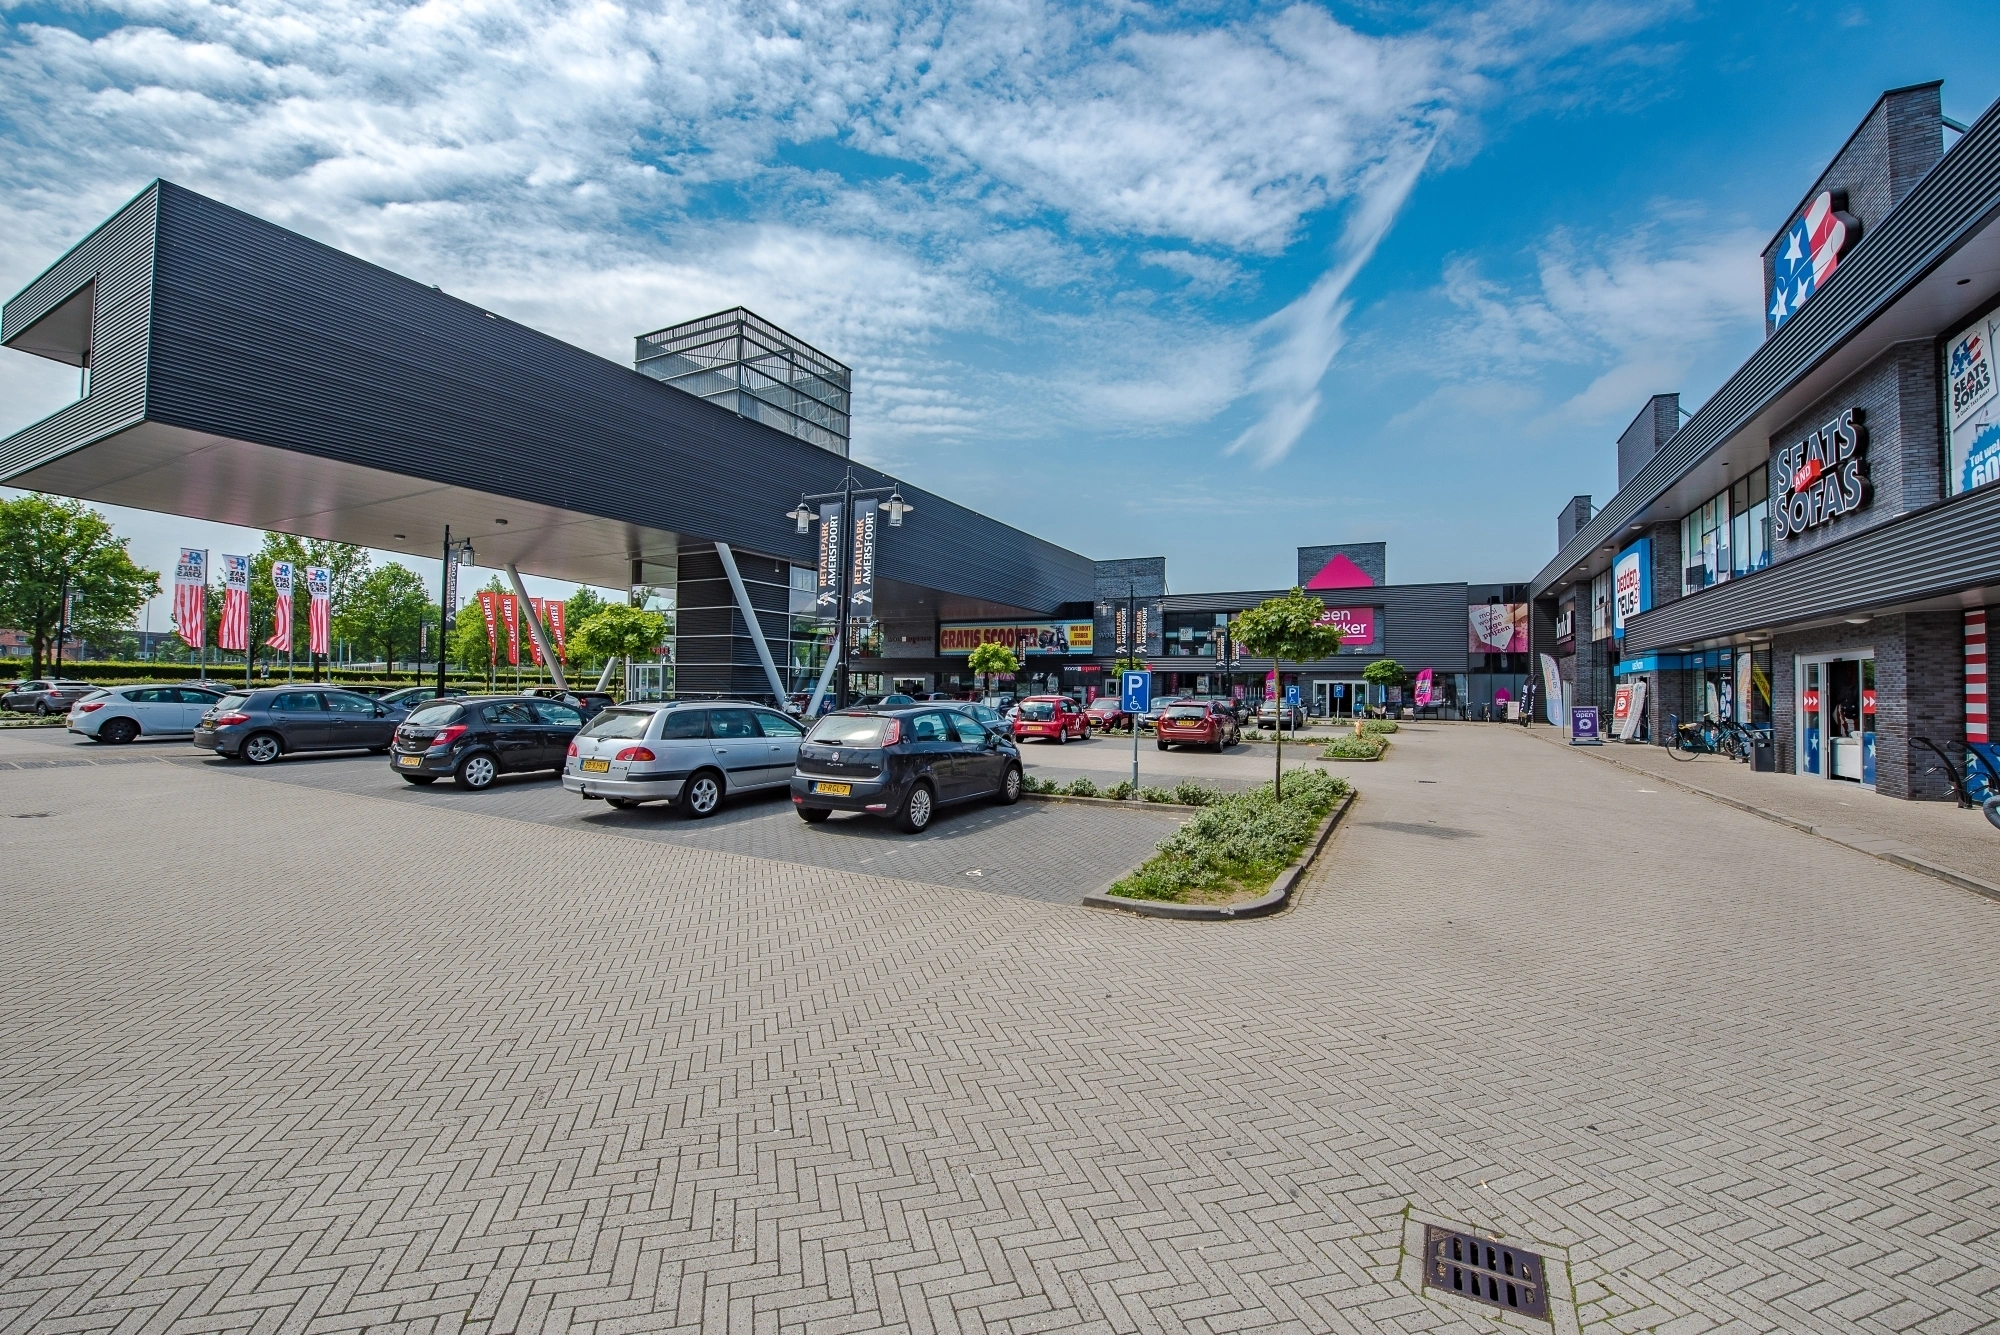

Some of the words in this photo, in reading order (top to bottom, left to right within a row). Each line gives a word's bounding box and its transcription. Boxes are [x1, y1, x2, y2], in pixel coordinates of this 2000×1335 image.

[1954, 358, 1987, 395] SEATS
[1954, 372, 1990, 413] SOFAS
[1777, 408, 1857, 496] SEATS
[1970, 451, 1983, 467] Tot
[1984, 439, 2000, 458] wel
[1795, 465, 1811, 488] AND
[1971, 453, 2000, 488] 60
[1775, 460, 1862, 541] SOFAS
[820, 522, 829, 586] RETAILPARK
[828, 515, 838, 586] AMERSFOORT
[854, 519, 865, 585] RETAILPARK
[863, 511, 874, 584] AMERSFOORT
[1617, 568, 1637, 594] bedden
[1320, 610, 1351, 621] een
[1478, 613, 1504, 626] wonen
[1479, 608, 1498, 619] mooi
[941, 629, 981, 649] GRATIS
[984, 628, 1038, 649] SCOOTER
[1313, 622, 1367, 634] kker
[1482, 625, 1511, 640] prijzen
[1128, 675, 1143, 695] P
[1289, 688, 1296, 697] P
[820, 784, 847, 792] 13-RGL-7
